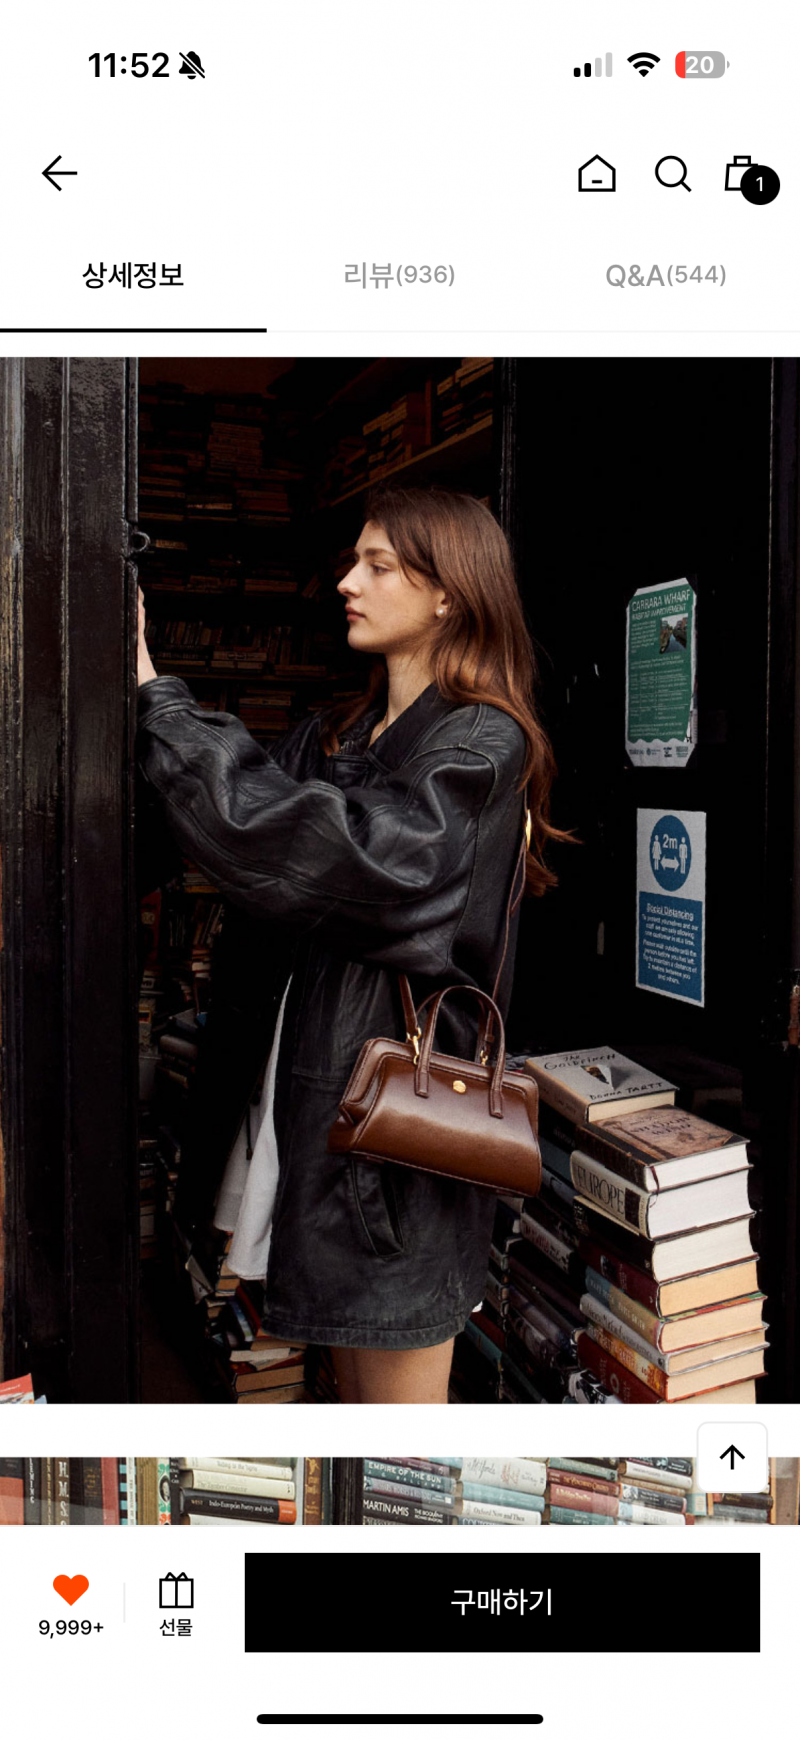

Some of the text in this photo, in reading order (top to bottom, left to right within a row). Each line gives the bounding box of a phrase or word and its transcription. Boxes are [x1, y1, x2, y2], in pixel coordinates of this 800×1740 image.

[88, 52, 170, 78] 11:52
[685, 56, 714, 74] 20
[755, 176, 763, 192] 1
[82, 262, 184, 289] 상세정보
[344, 262, 456, 289] 리뷰(936)
[606, 264, 727, 288] Q&A(544)
[632, 589, 690, 611] CARRARA WHARF
[662, 834, 678, 849] 2m
[626, 1082, 664, 1095] TARTT
[577, 1165, 626, 1215] EUROPE
[368, 1462, 396, 1474] EMPIRE
[398, 1466, 407, 1476] OF
[410, 1470, 424, 1480] THE
[427, 1474, 441, 1484] SUN
[363, 1500, 409, 1517] MARTIN AMIS
[450, 1588, 553, 1616] 구매하기
[38, 1619, 104, 1639] 9,999+
[159, 1618, 193, 1637] 선물
